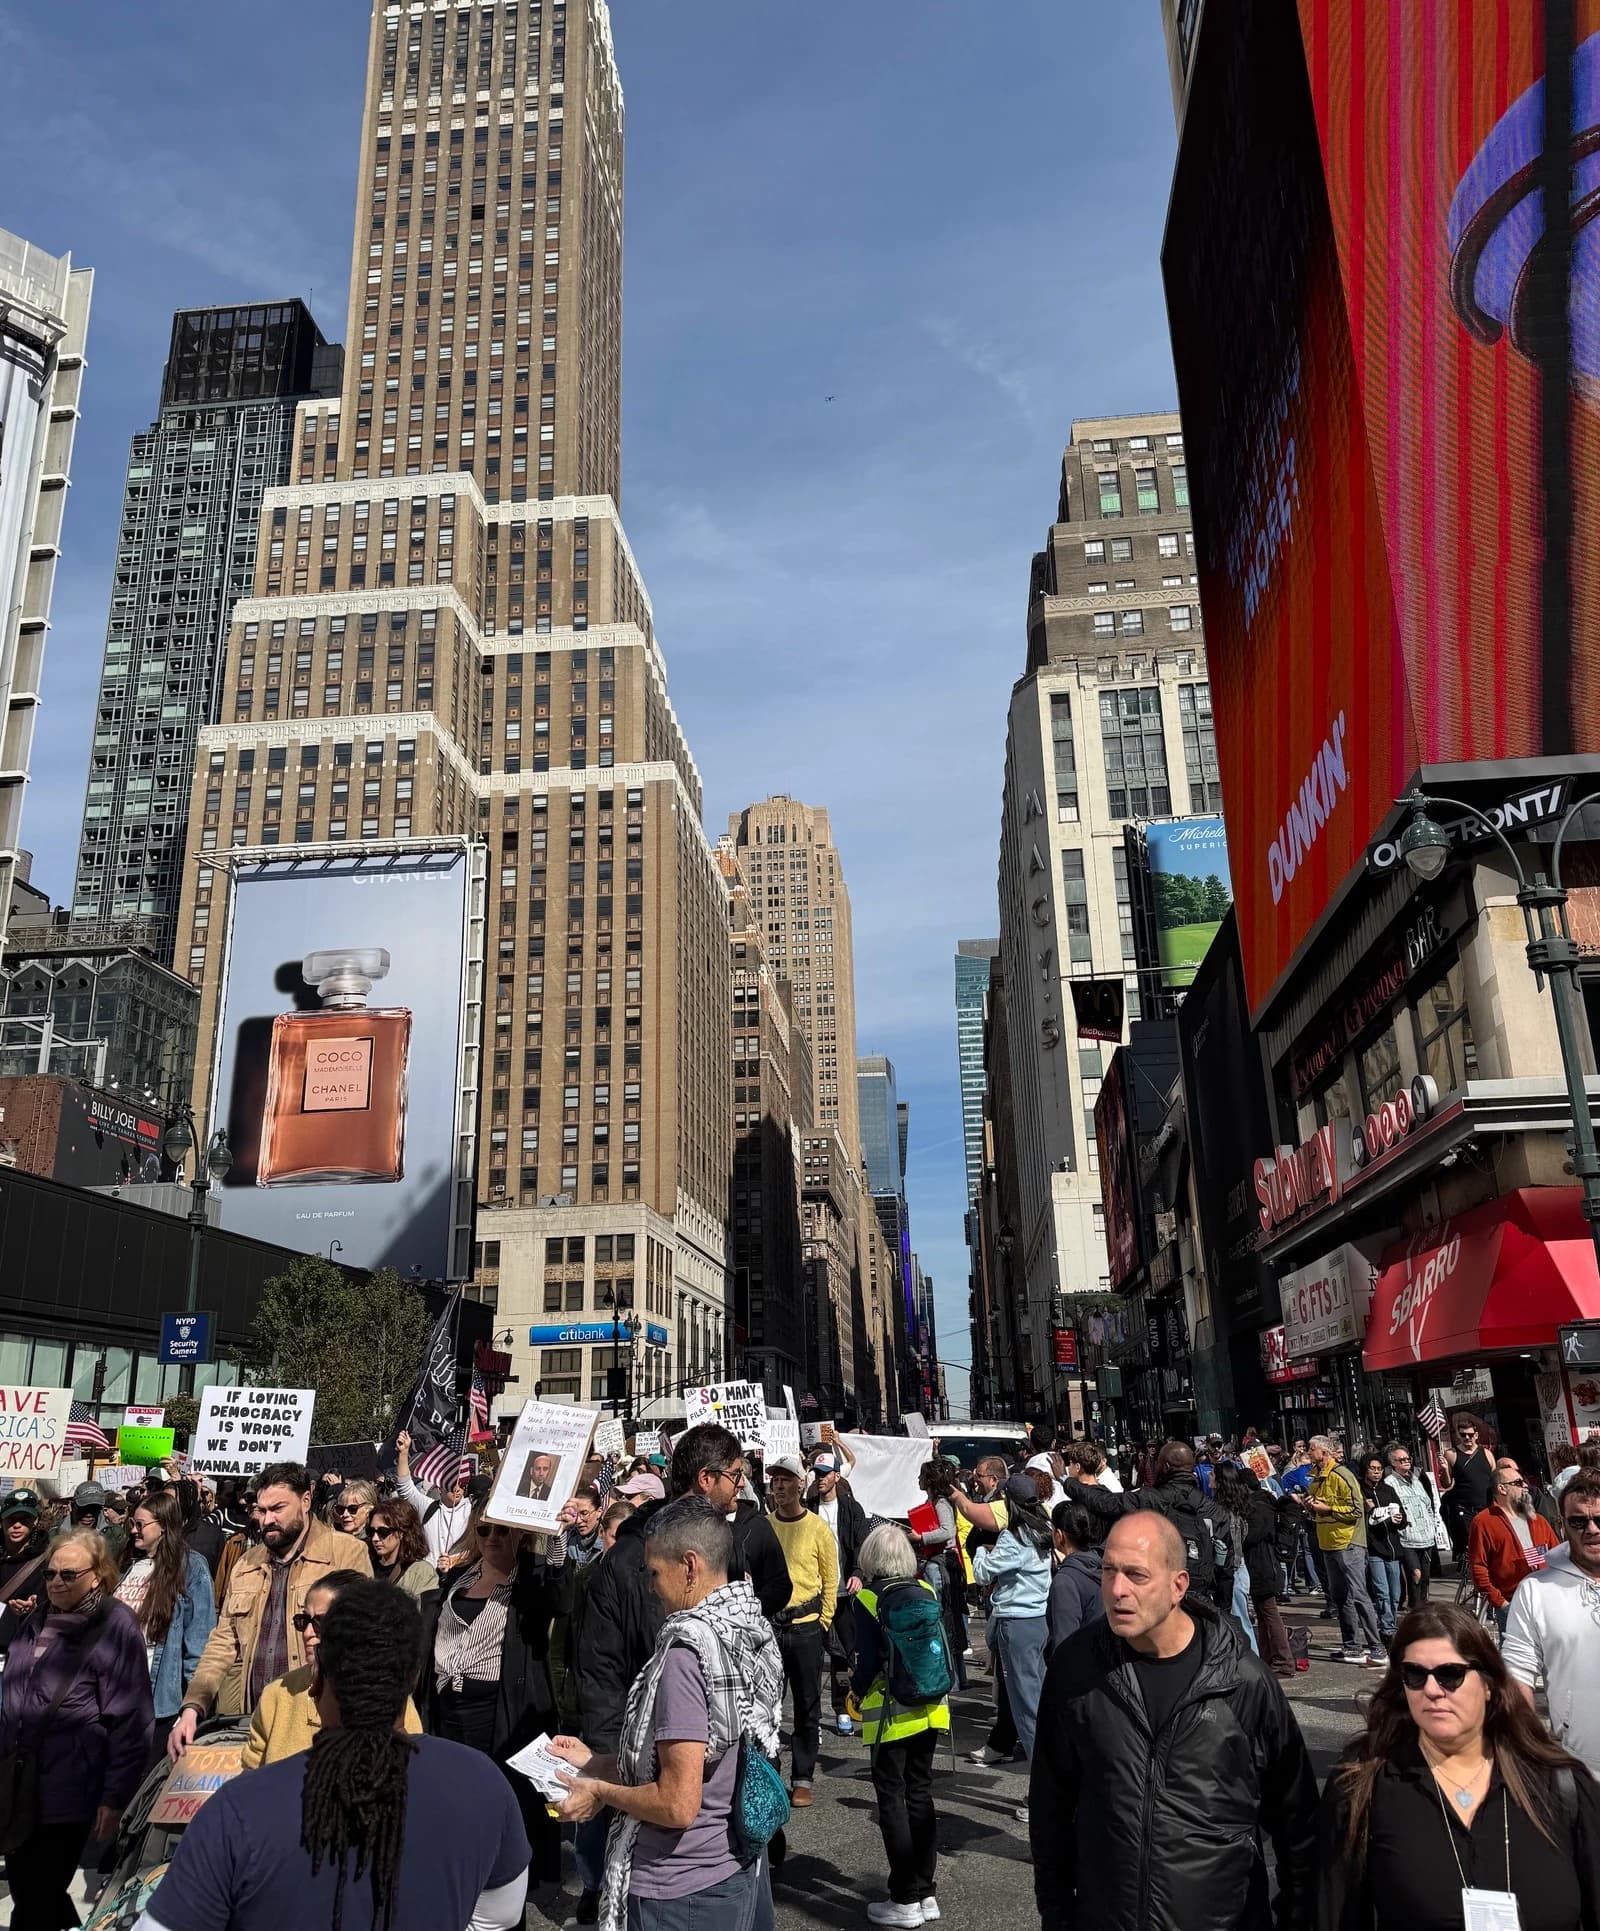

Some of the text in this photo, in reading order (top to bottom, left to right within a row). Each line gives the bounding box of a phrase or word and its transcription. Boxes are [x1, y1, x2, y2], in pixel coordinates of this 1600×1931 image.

[1268, 710, 1346, 906] DUNKIN'
[352, 868, 452, 885] CHANEL
[1405, 906, 1443, 969] BAR
[317, 1051, 362, 1063] COCO
[312, 1084, 362, 1094] CHANEL
[92, 1101, 115, 1120] BILLY
[115, 1111, 137, 1131] JOEL
[1254, 1119, 1337, 1232] Subway
[324, 1210, 354, 1218] PARFUM
[1389, 1232, 1461, 1335] SBARRO
[175, 1317, 197, 1325] NYPD
[559, 1328, 605, 1341] citibank
[170, 1339, 198, 1348] Security
[226, 1391, 298, 1406] IF LOVING
[700, 1385, 756, 1404] SO MANY
[210, 1405, 303, 1421] DEMOCRACY
[689, 1406, 708, 1421] FILES
[218, 1421, 295, 1438] IS WRONG,
[207, 1439, 282, 1453] WE DON'T
[193, 1459, 240, 1473] WANNA
[243, 1462, 261, 1474] BE
[188, 1750, 240, 1771] TOTS
[169, 1775, 230, 1791] AGAIN
